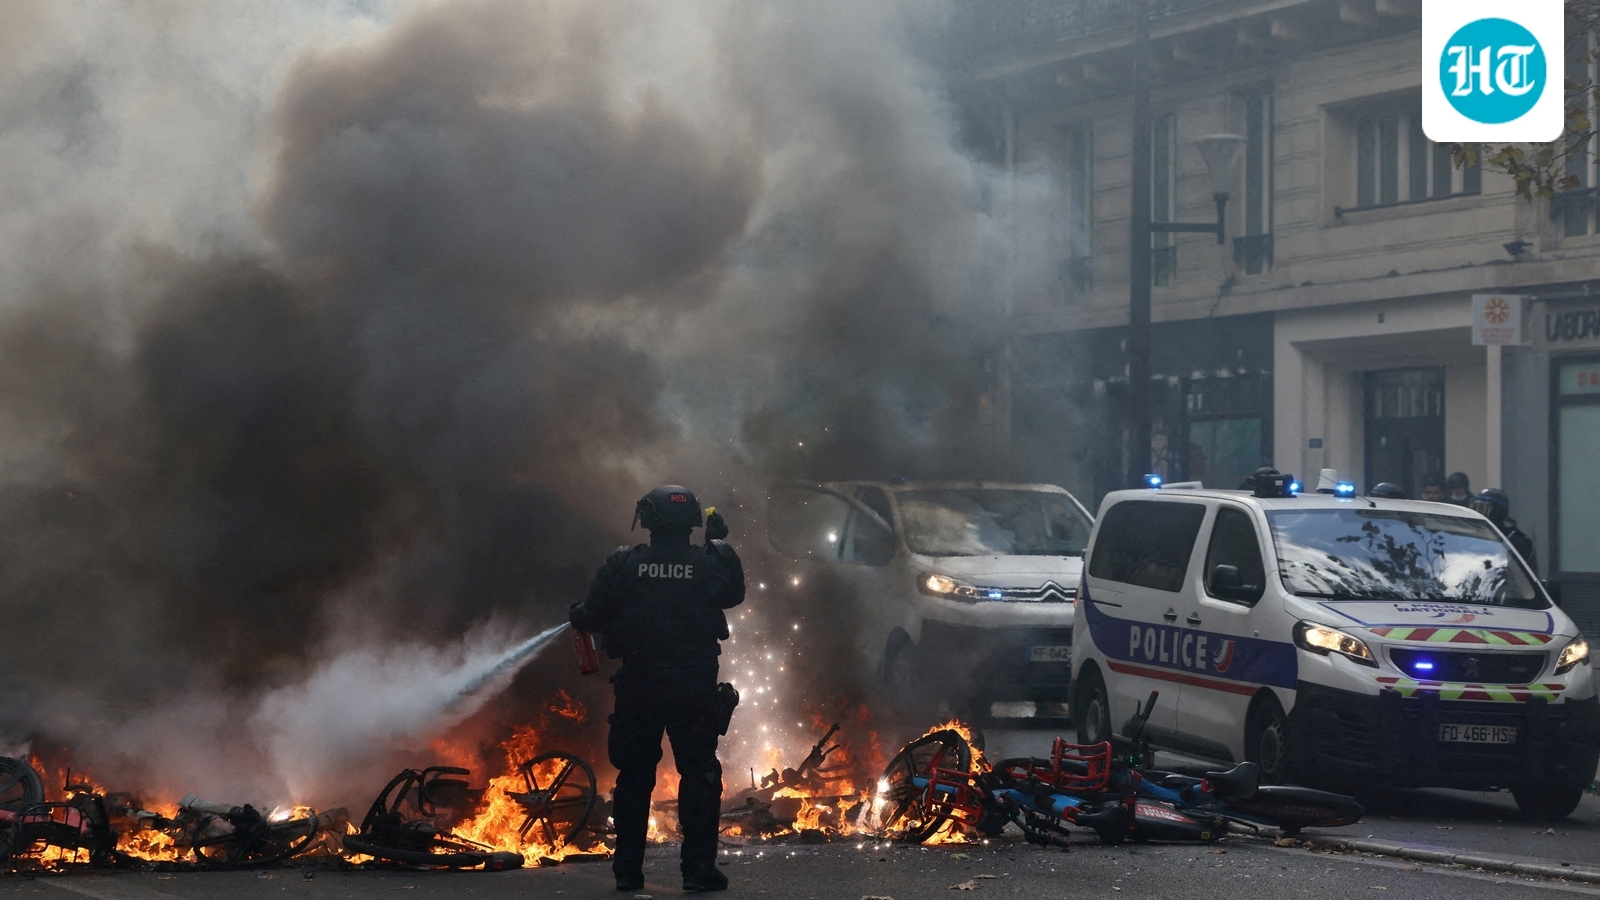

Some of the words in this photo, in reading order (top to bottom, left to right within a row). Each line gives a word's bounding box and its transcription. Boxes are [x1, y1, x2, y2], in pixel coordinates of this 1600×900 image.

[638, 563, 694, 579] POLICE
[1397, 607, 1494, 616] NATIONALE
[1129, 625, 1207, 669] POLICE
[1441, 725, 1508, 742] FD-466-HS
